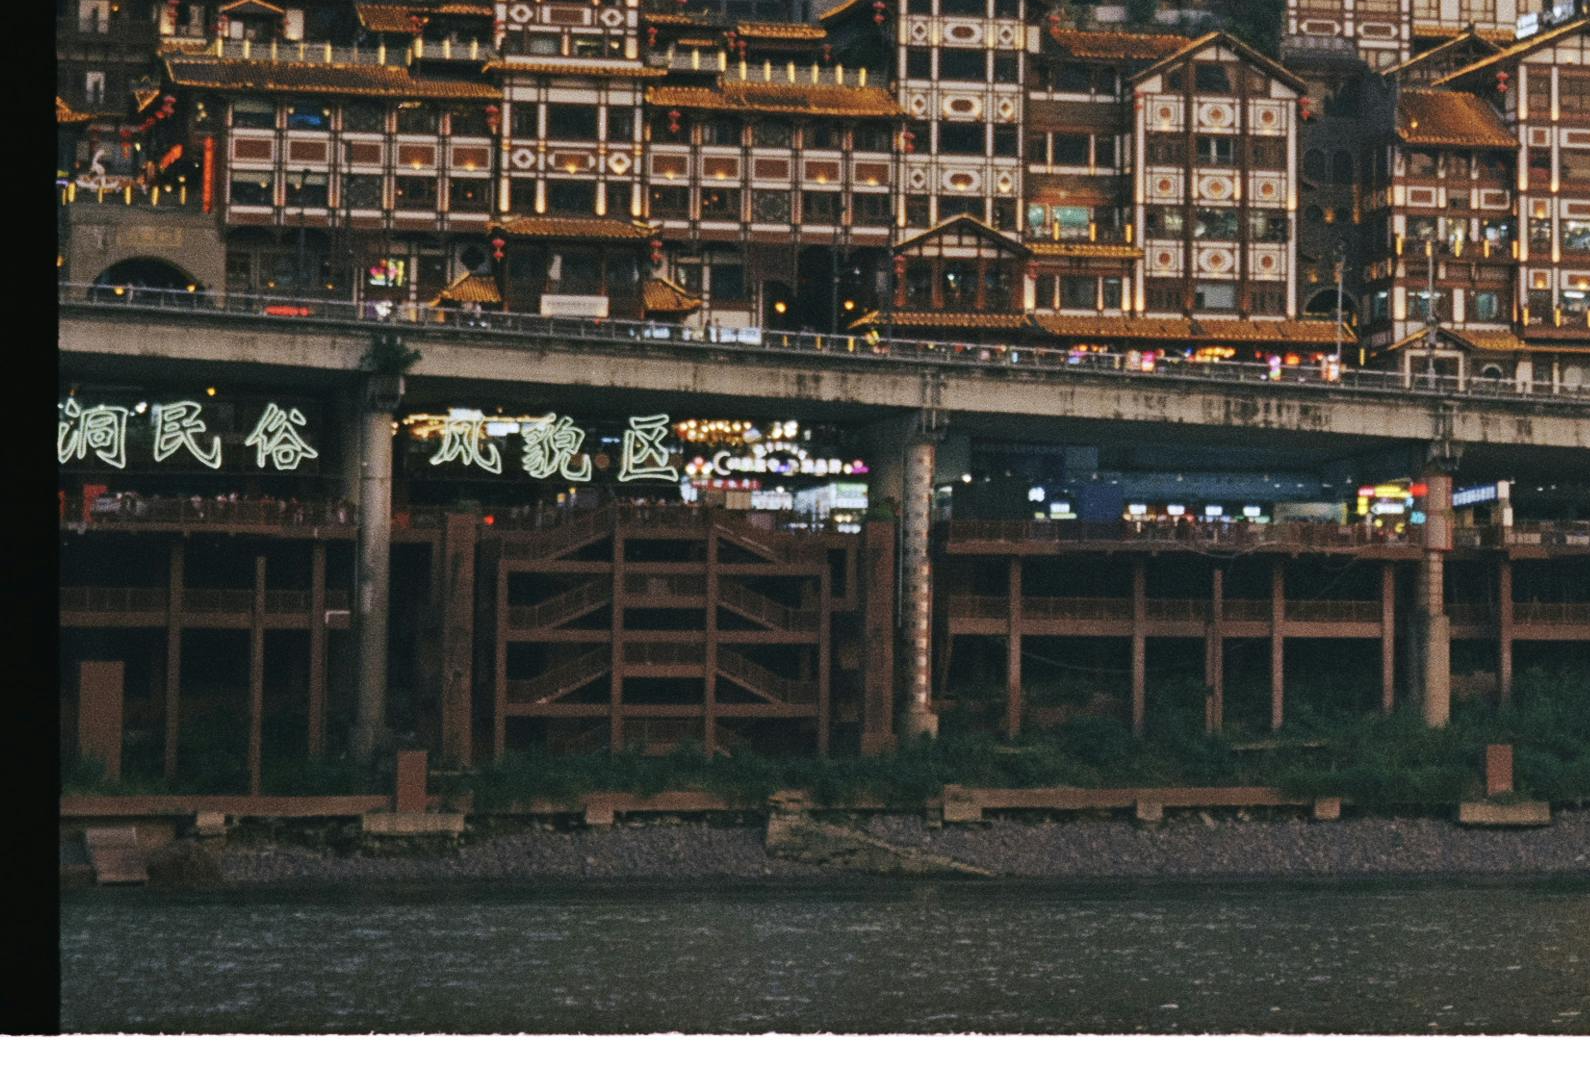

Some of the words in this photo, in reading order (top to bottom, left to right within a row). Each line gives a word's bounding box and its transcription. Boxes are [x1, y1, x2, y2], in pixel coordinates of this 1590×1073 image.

[57, 401, 319, 470] 洞民俗
[430, 413, 679, 483] 风貌区
